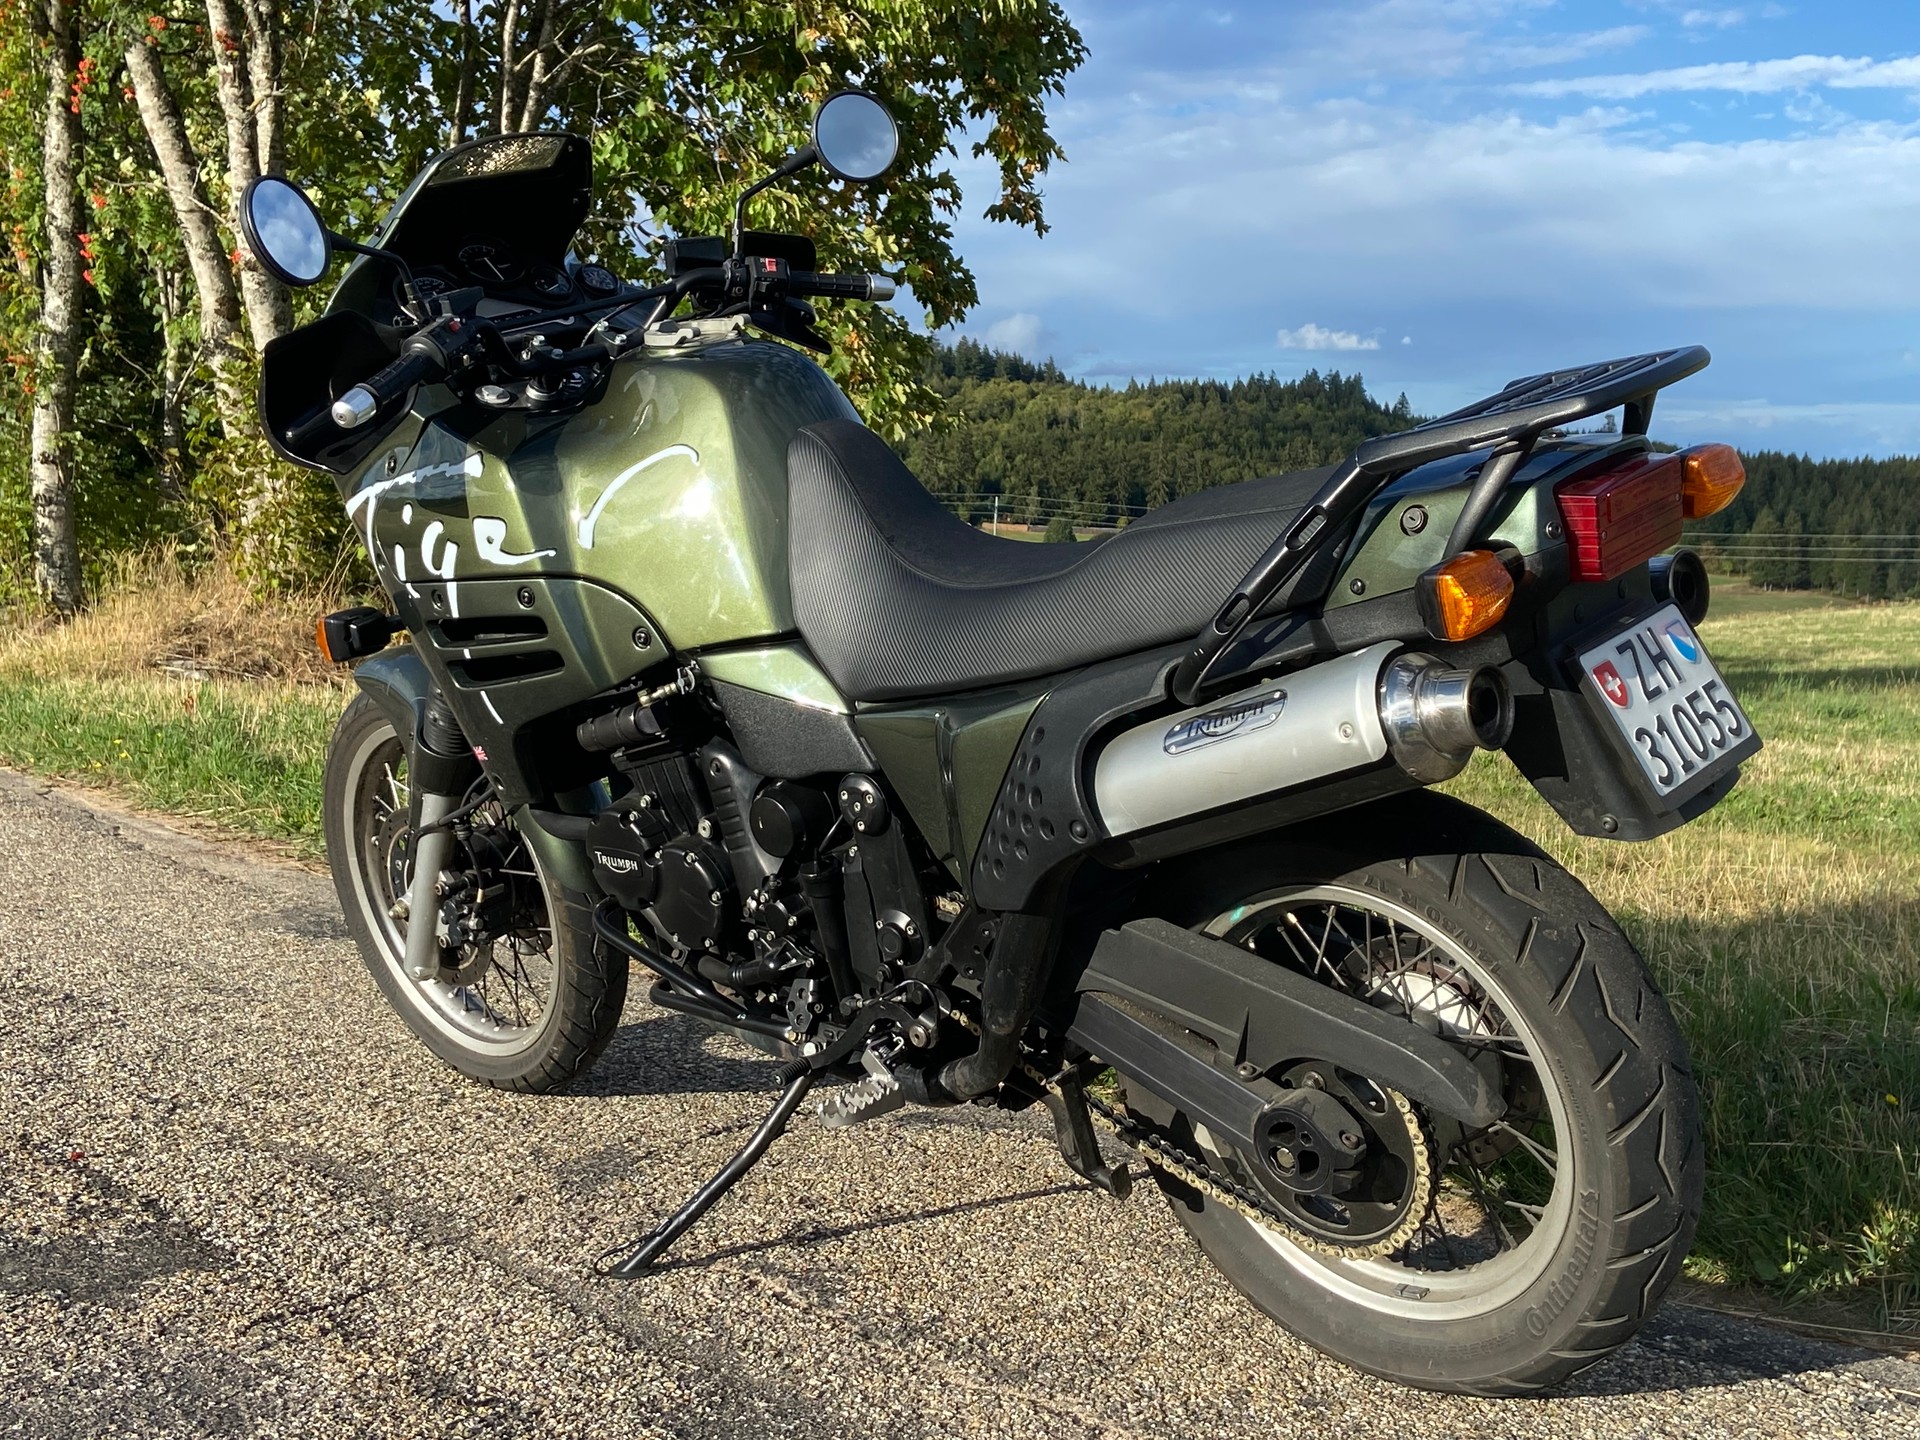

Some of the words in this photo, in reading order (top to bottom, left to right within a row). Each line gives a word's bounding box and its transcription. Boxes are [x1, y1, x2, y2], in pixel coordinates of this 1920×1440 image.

[346, 444, 699, 724] Tiger
[1615, 627, 1683, 701] ZH
[1187, 701, 1265, 738] TRIUMPH
[1635, 679, 1743, 786] 31055
[594, 850, 639, 872] TRIUMPH
